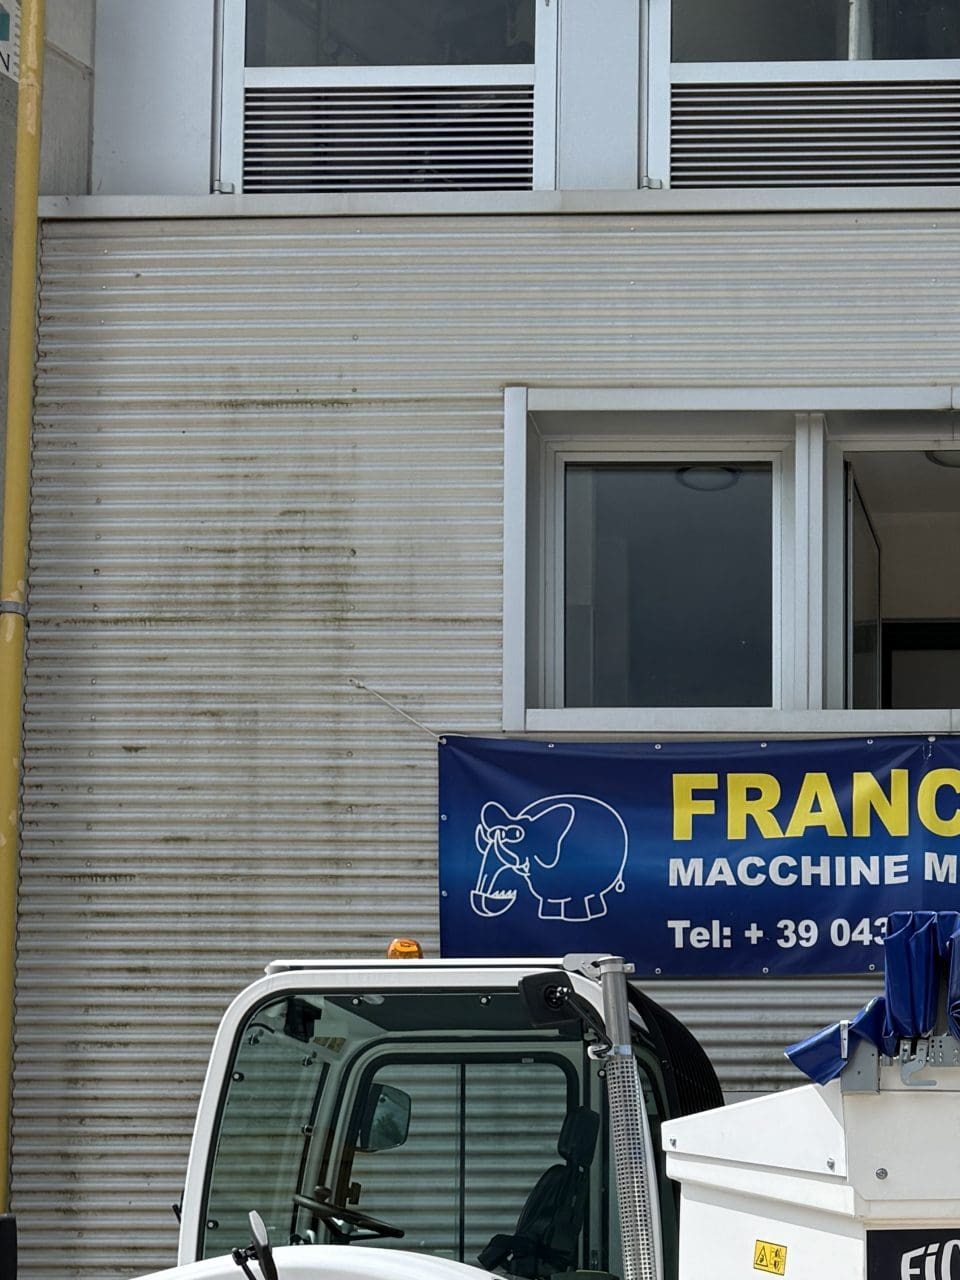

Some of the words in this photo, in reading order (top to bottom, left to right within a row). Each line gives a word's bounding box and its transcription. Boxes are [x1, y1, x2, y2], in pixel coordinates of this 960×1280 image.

[668, 855, 909, 887] MACCHINE
[667, 920, 731, 948] Tel:
[745, 923, 764, 944] +
[776, 919, 818, 948] 39
